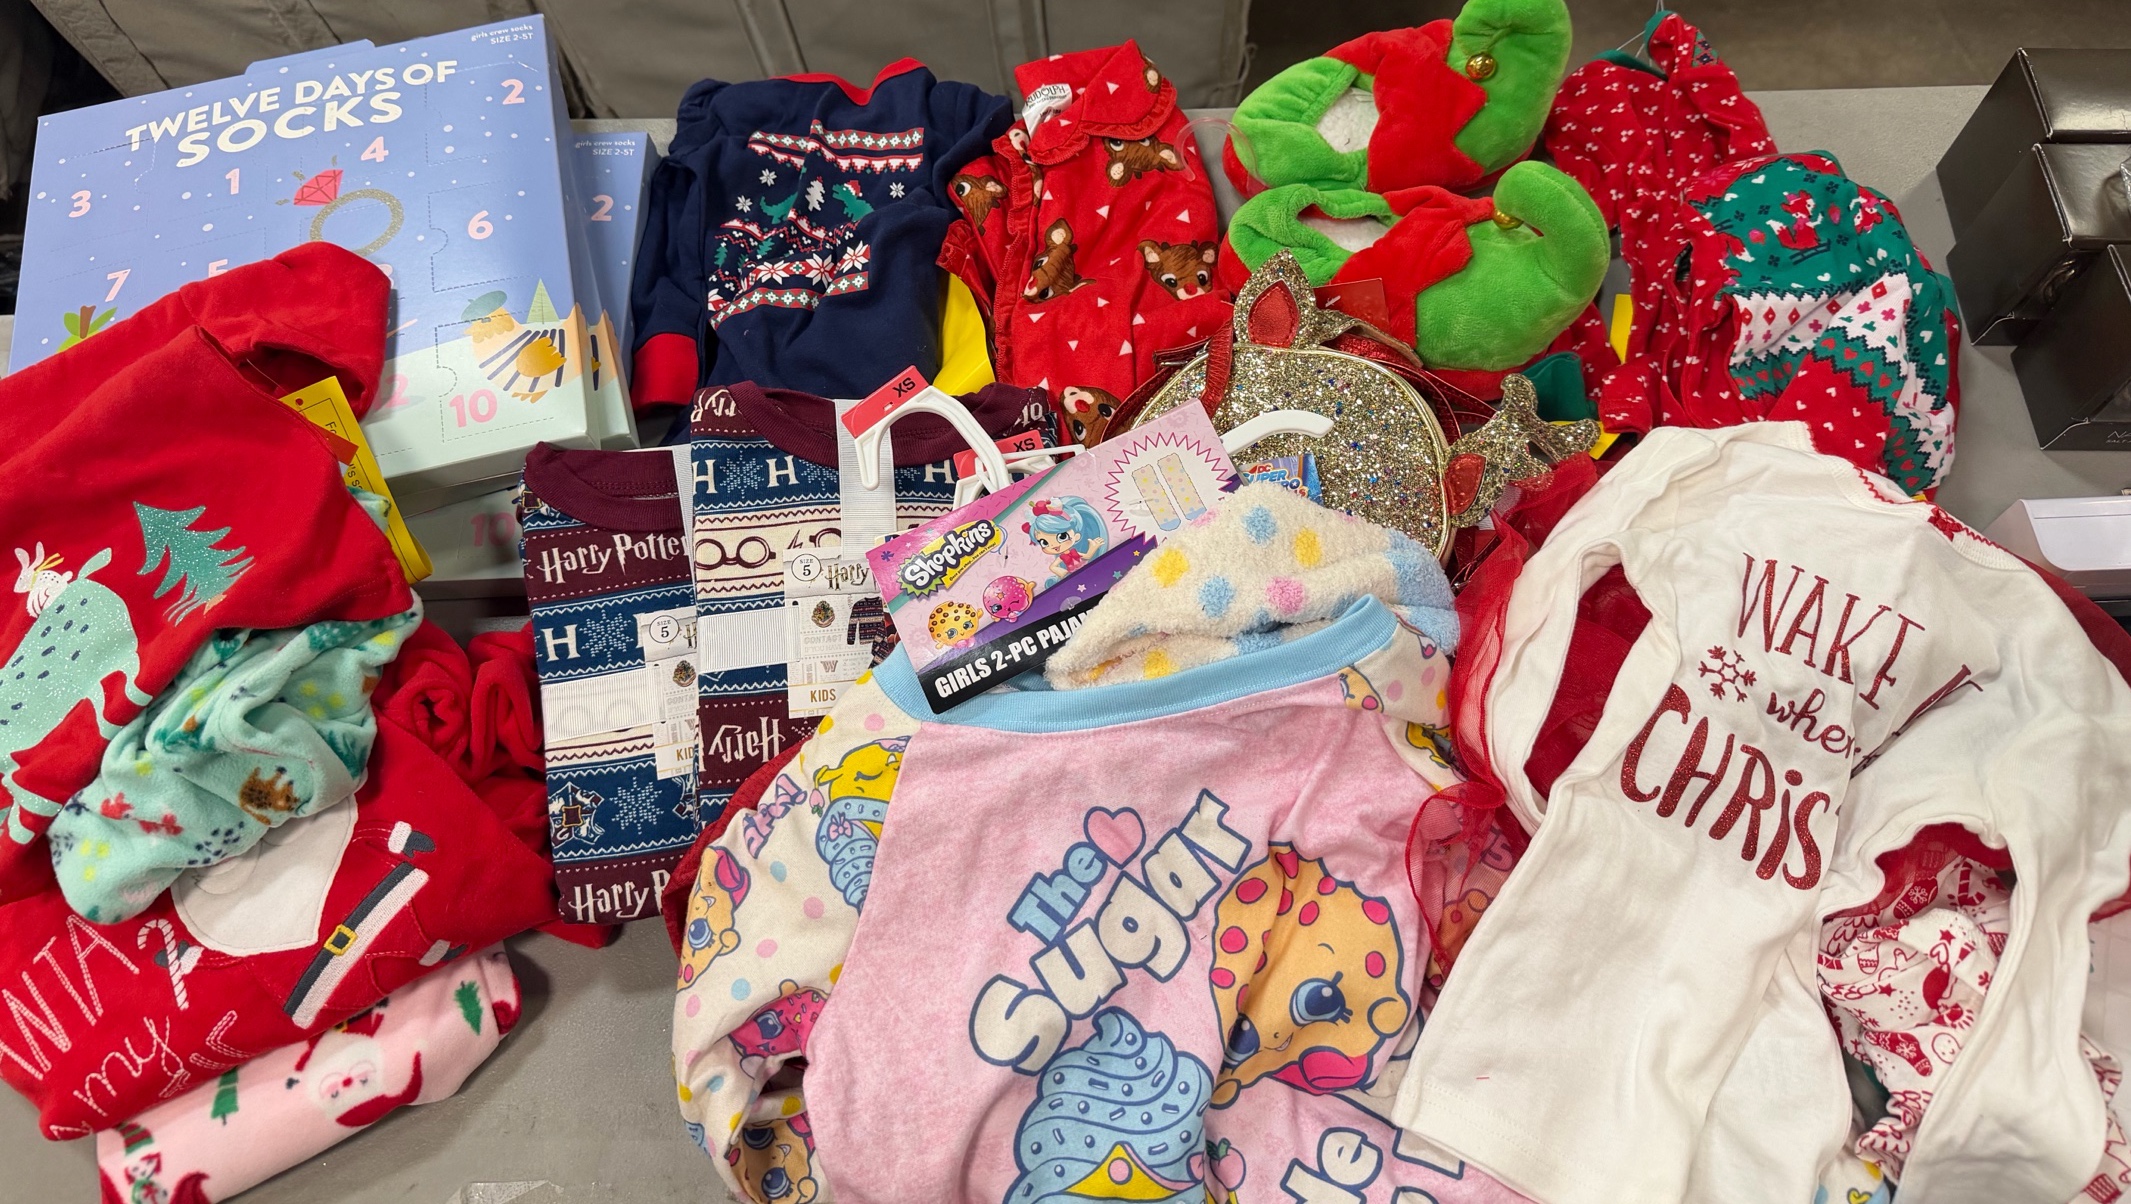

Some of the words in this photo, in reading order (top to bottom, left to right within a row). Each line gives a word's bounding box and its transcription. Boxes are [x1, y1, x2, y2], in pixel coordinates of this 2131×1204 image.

[471, 31, 488, 42] girls
[489, 28, 509, 36] crew
[510, 24, 533, 32] socks
[490, 34, 511, 45] SIZE
[125, 87, 281, 151] TWELVE
[295, 68, 396, 104] DAYS
[402, 60, 458, 86] OF
[501, 78, 525, 105] 2
[176, 91, 403, 168] SOCKS
[575, 140, 592, 149] girls
[614, 138, 636, 147] socks
[361, 136, 389, 162] 4
[592, 148, 613, 156] SIZE
[225, 168, 240, 195] 1
[68, 189, 92, 218] 3
[592, 195, 613, 222] 2
[467, 210, 493, 241] 6
[105, 269, 131, 302] 7
[892, 376, 917, 399] XS
[449, 388, 498, 428] 10
[1013, 437, 1036, 452] XS
[766, 455, 800, 488] H
[1258, 464, 1272, 473] DC
[470, 511, 516, 547] 10
[537, 538, 612, 585] Harry
[904, 521, 992, 587] Shopkins
[802, 564, 812, 577] 5
[824, 562, 871, 591] Harry
[656, 619, 672, 627] SIZE
[660, 626, 670, 639] 5
[540, 624, 581, 661] H
[934, 657, 992, 699] GIRLS
[990, 636, 1038, 672] 2-PC
[810, 688, 837, 703] KIDS
[708, 716, 787, 764] Harry
[568, 879, 650, 925] Harry
[1007, 840, 1107, 943] The
[969, 788, 1253, 1077] Sugar
[72, 1016, 187, 1117] my
